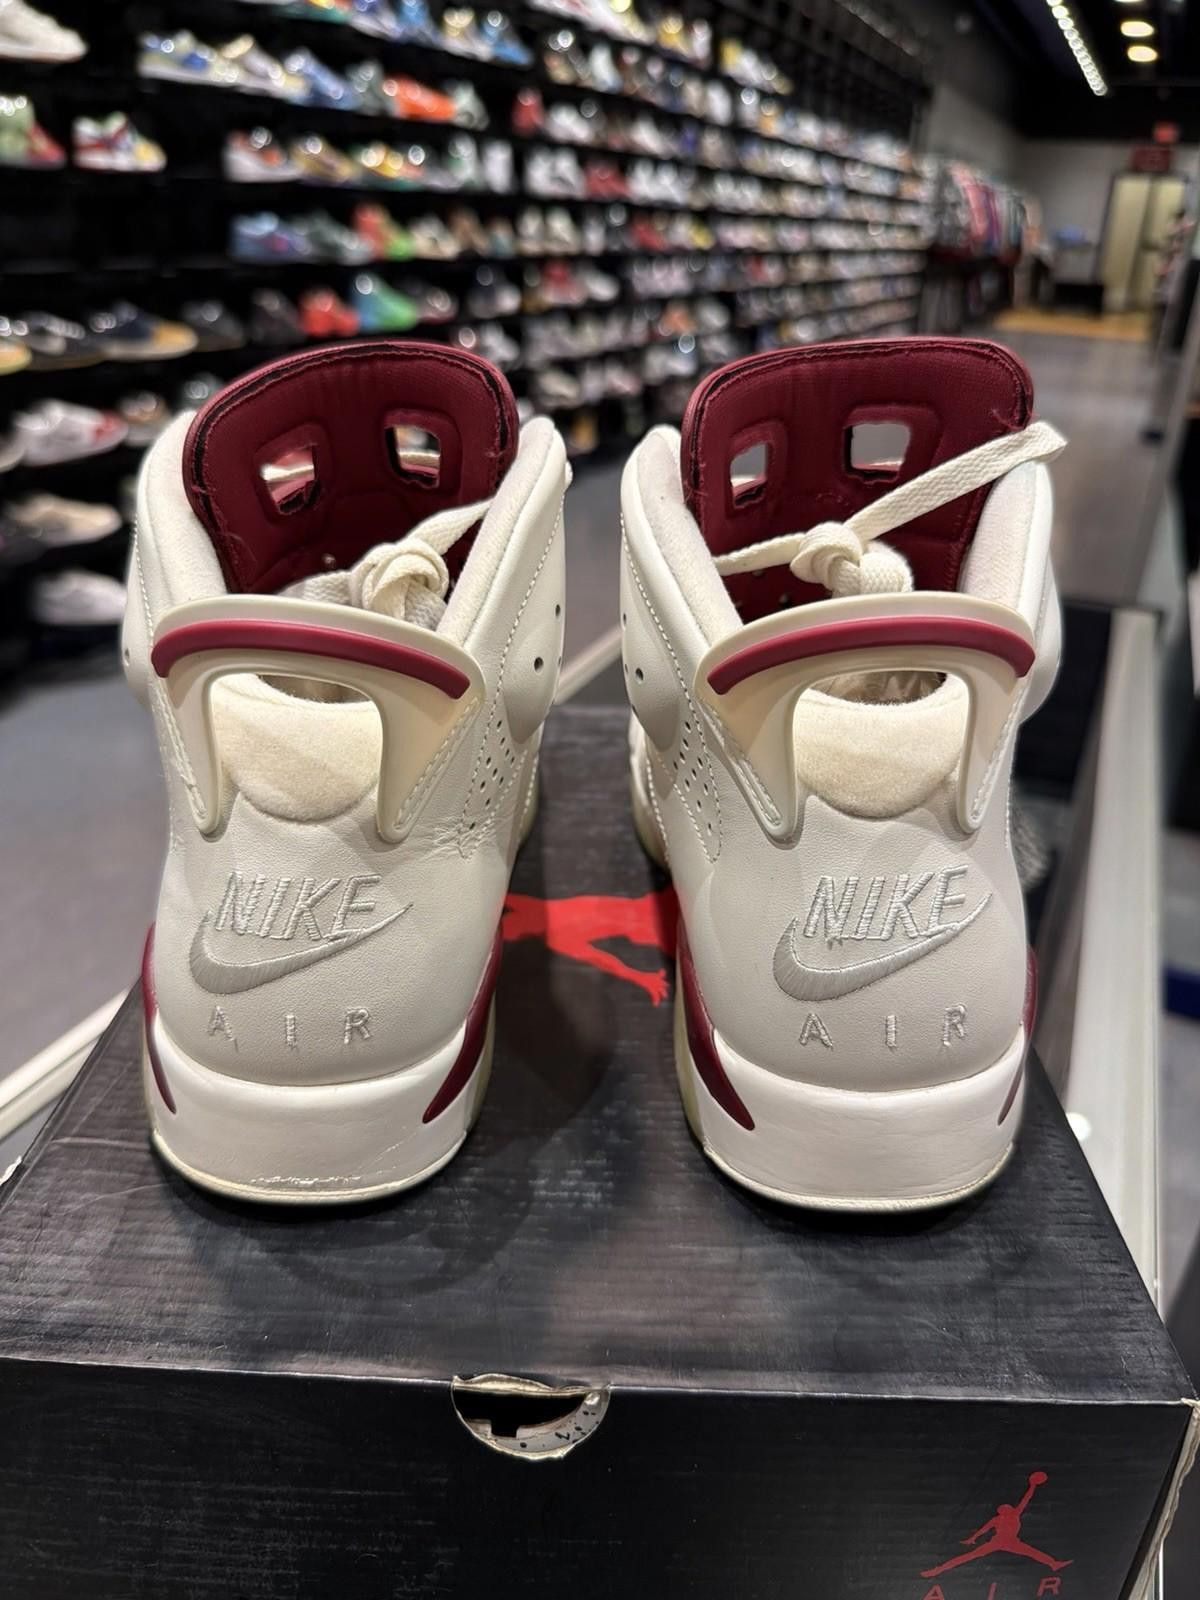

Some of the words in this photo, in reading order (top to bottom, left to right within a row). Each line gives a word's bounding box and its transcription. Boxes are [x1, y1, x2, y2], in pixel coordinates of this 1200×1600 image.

[215, 871, 382, 941] NIKE
[803, 865, 969, 942] NIKE
[207, 1005, 372, 1048] AIR
[800, 1003, 968, 1047] AIR
[922, 1577, 1061, 1600] AIR
